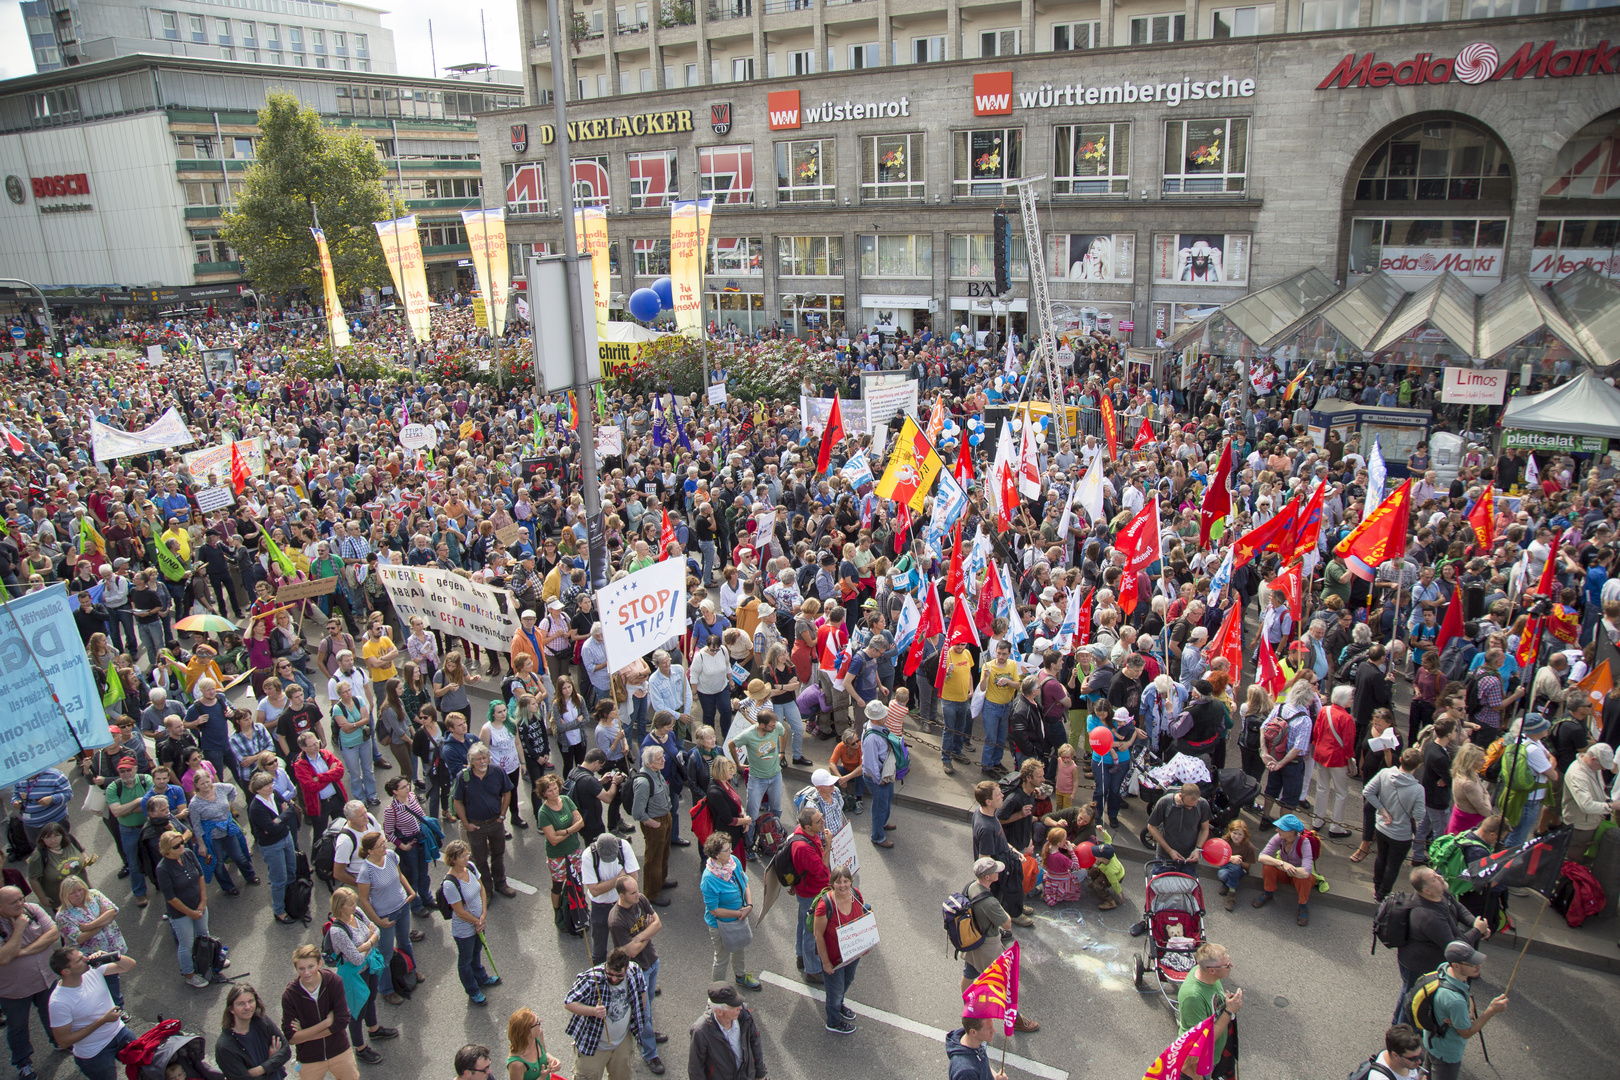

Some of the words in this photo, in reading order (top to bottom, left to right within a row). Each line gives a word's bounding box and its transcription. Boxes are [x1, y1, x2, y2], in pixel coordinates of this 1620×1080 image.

[1315, 52, 1455, 90] Media
[1490, 40, 1620, 81] Mark
[1019, 75, 1256, 108] württembergische
[805, 96, 910, 123] wüstenrot
[540, 109, 694, 145] DNKELACKER
[30, 173, 90, 197] BOSCH
[1382, 253, 1419, 271] edia
[1432, 253, 1495, 271] Markt
[599, 343, 630, 360] chritt
[1457, 369, 1498, 387] Limos
[1507, 433, 1574, 447] plattsalat
[159, 553, 179, 570] BUND
[436, 578, 465, 592] gegen
[392, 586, 425, 598] ABBAU
[430, 592, 447, 604] der
[451, 596, 502, 622] Demokratie
[618, 589, 670, 626] STOP
[440, 611, 466, 628] CETA
